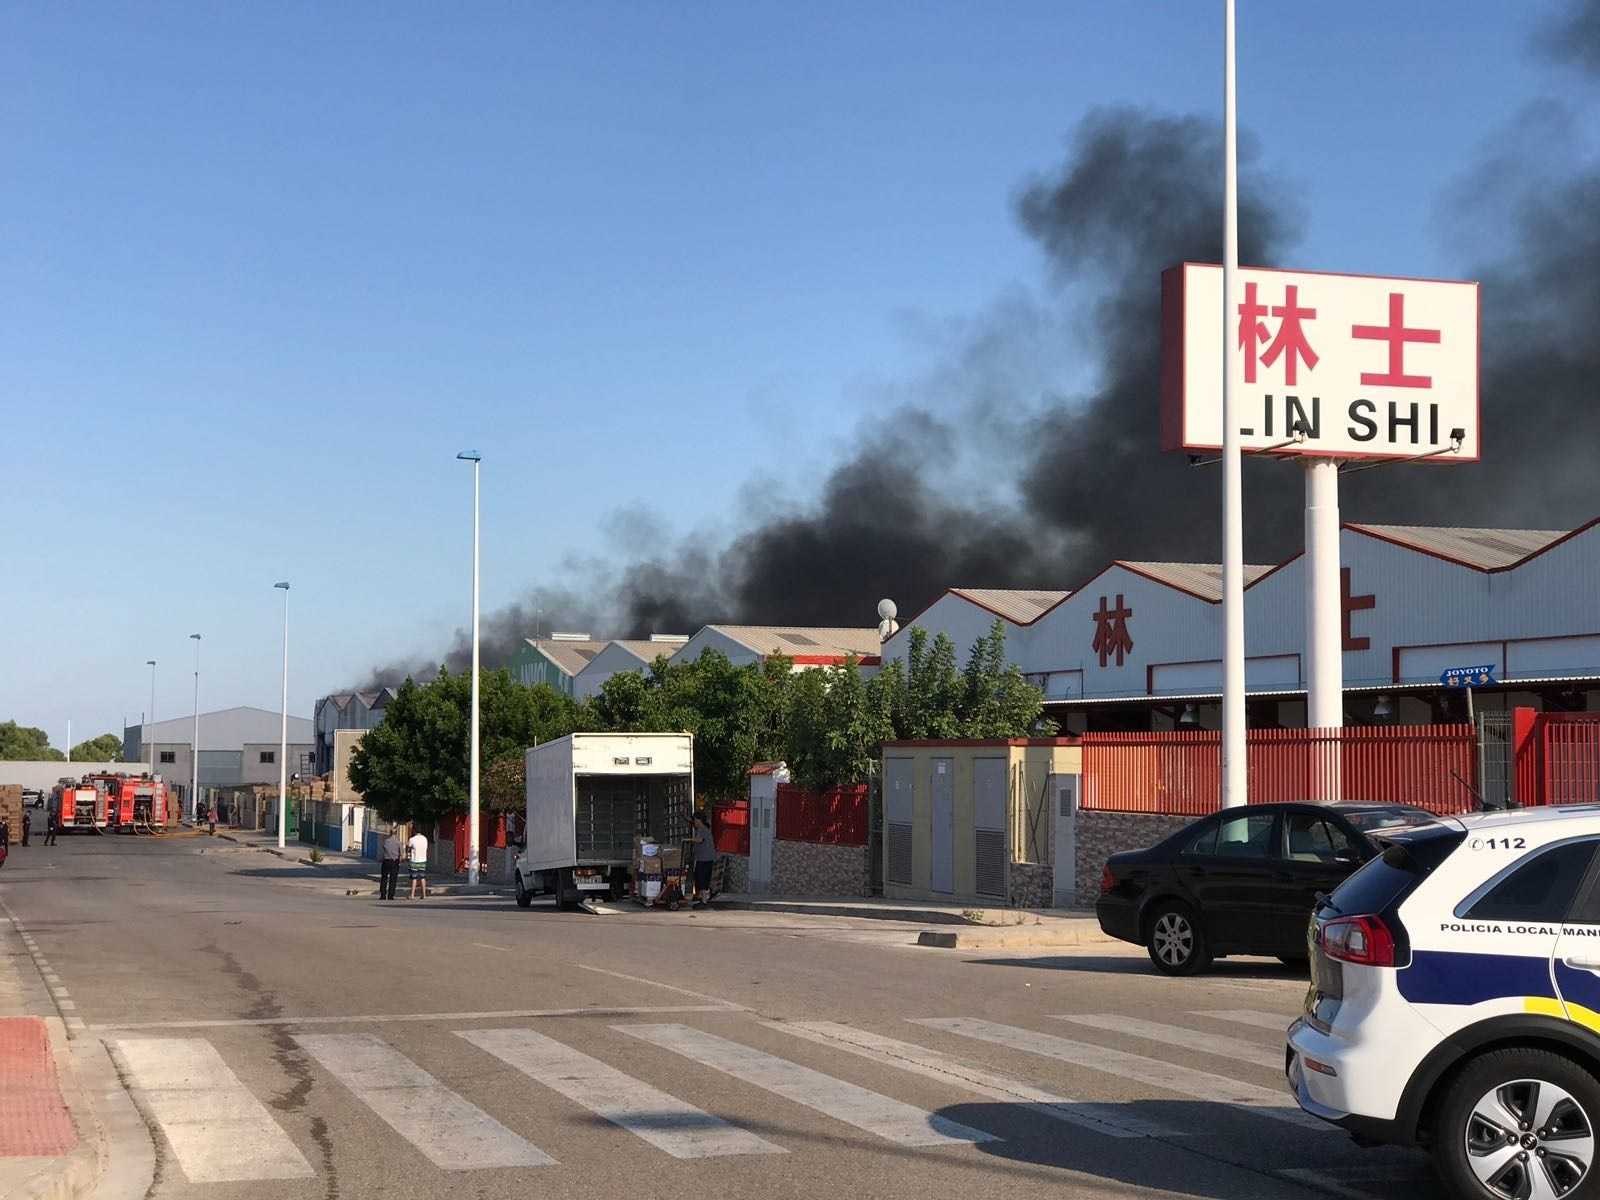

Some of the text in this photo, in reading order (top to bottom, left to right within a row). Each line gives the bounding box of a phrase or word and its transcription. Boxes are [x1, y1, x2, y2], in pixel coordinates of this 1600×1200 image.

[1240, 394, 1438, 445] IN SHI
[1092, 594, 1133, 667] 林
[1446, 667, 1489, 677] JOYOTO
[1486, 837, 1527, 849] 112
[1440, 923, 1503, 934] POLICIA
[1507, 925, 1558, 936] LOCAL
